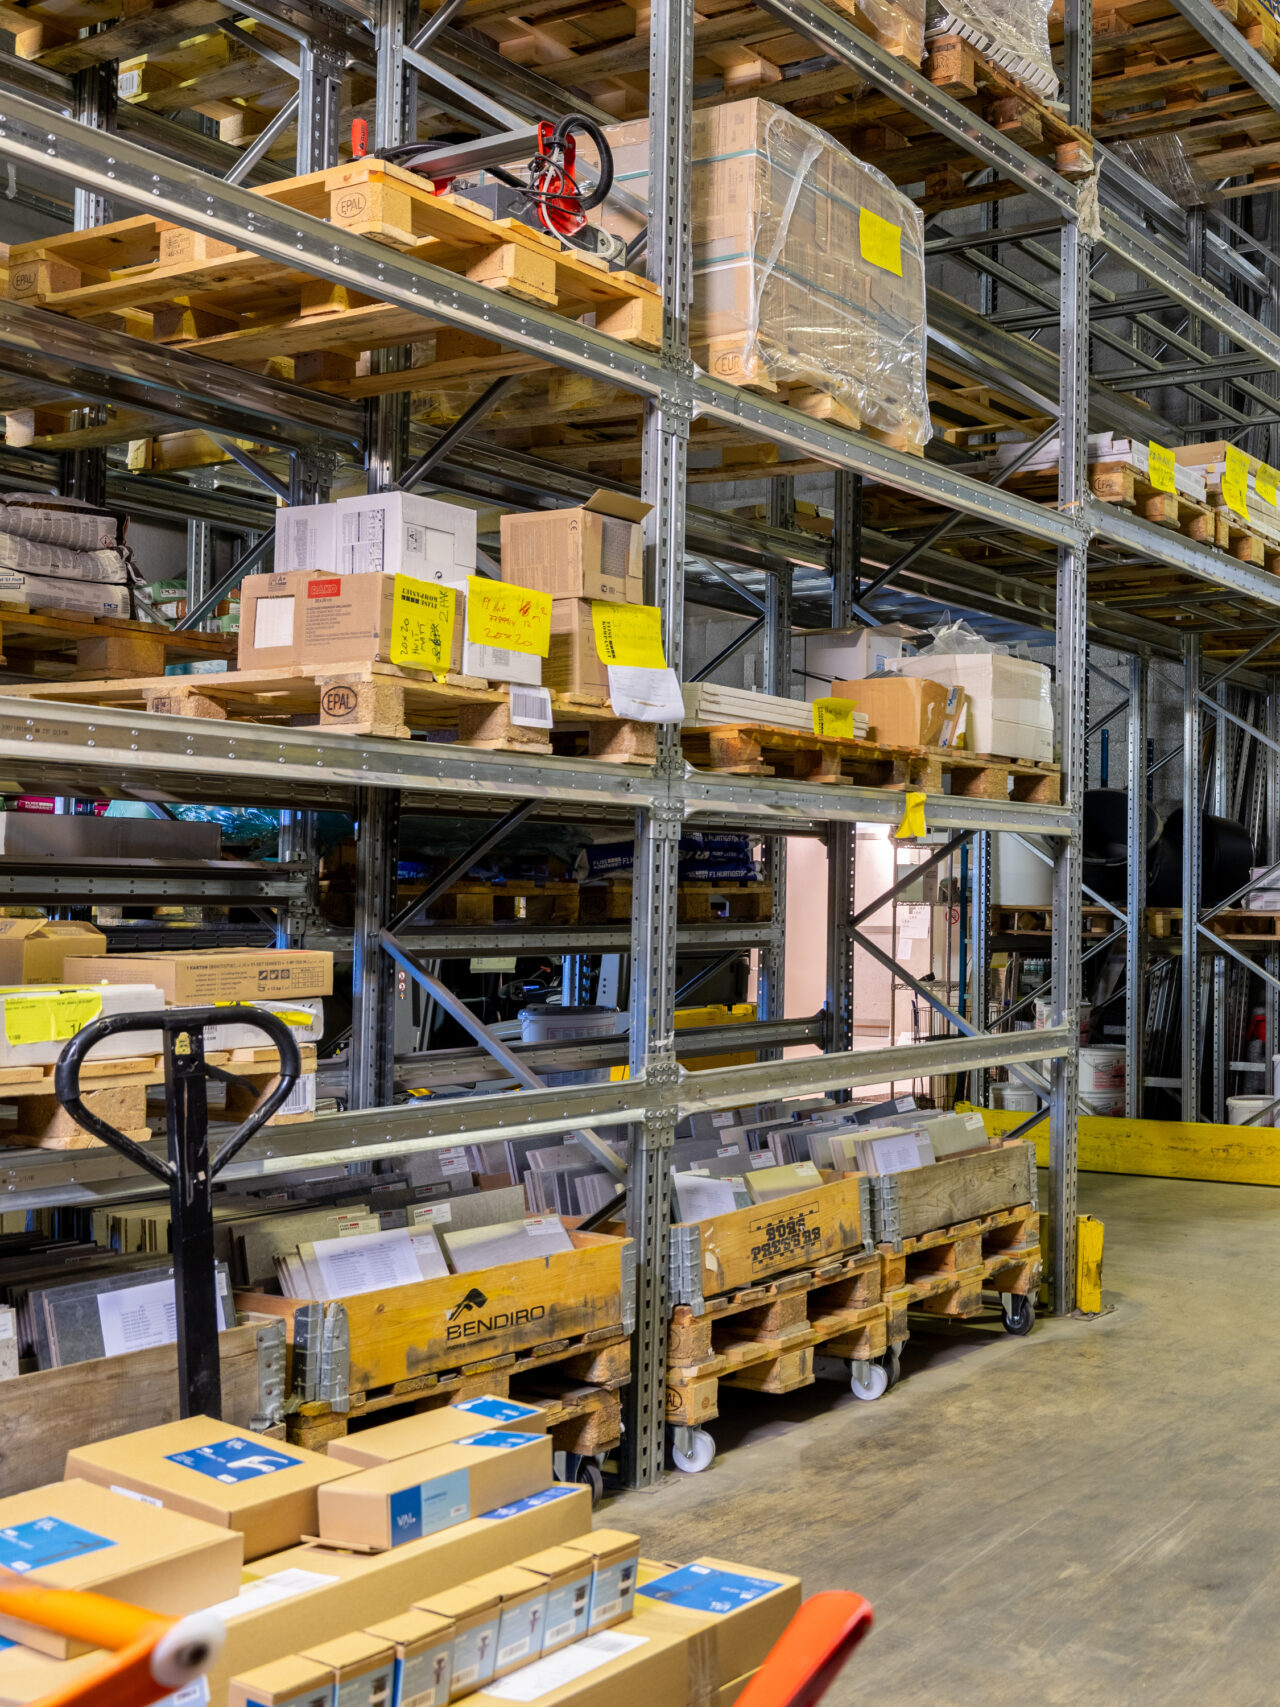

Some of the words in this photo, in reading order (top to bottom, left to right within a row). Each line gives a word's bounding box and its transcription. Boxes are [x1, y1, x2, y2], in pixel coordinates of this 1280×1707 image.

[340, 196, 364, 214] EPAL
[15, 272, 36, 288] EPAL
[311, 584, 338, 595] RAKO
[402, 587, 438, 602] KOMPANIET
[420, 600, 438, 609] FLISE
[327, 694, 353, 711] EPAL
[447, 1305, 545, 1341] BENDIRO
